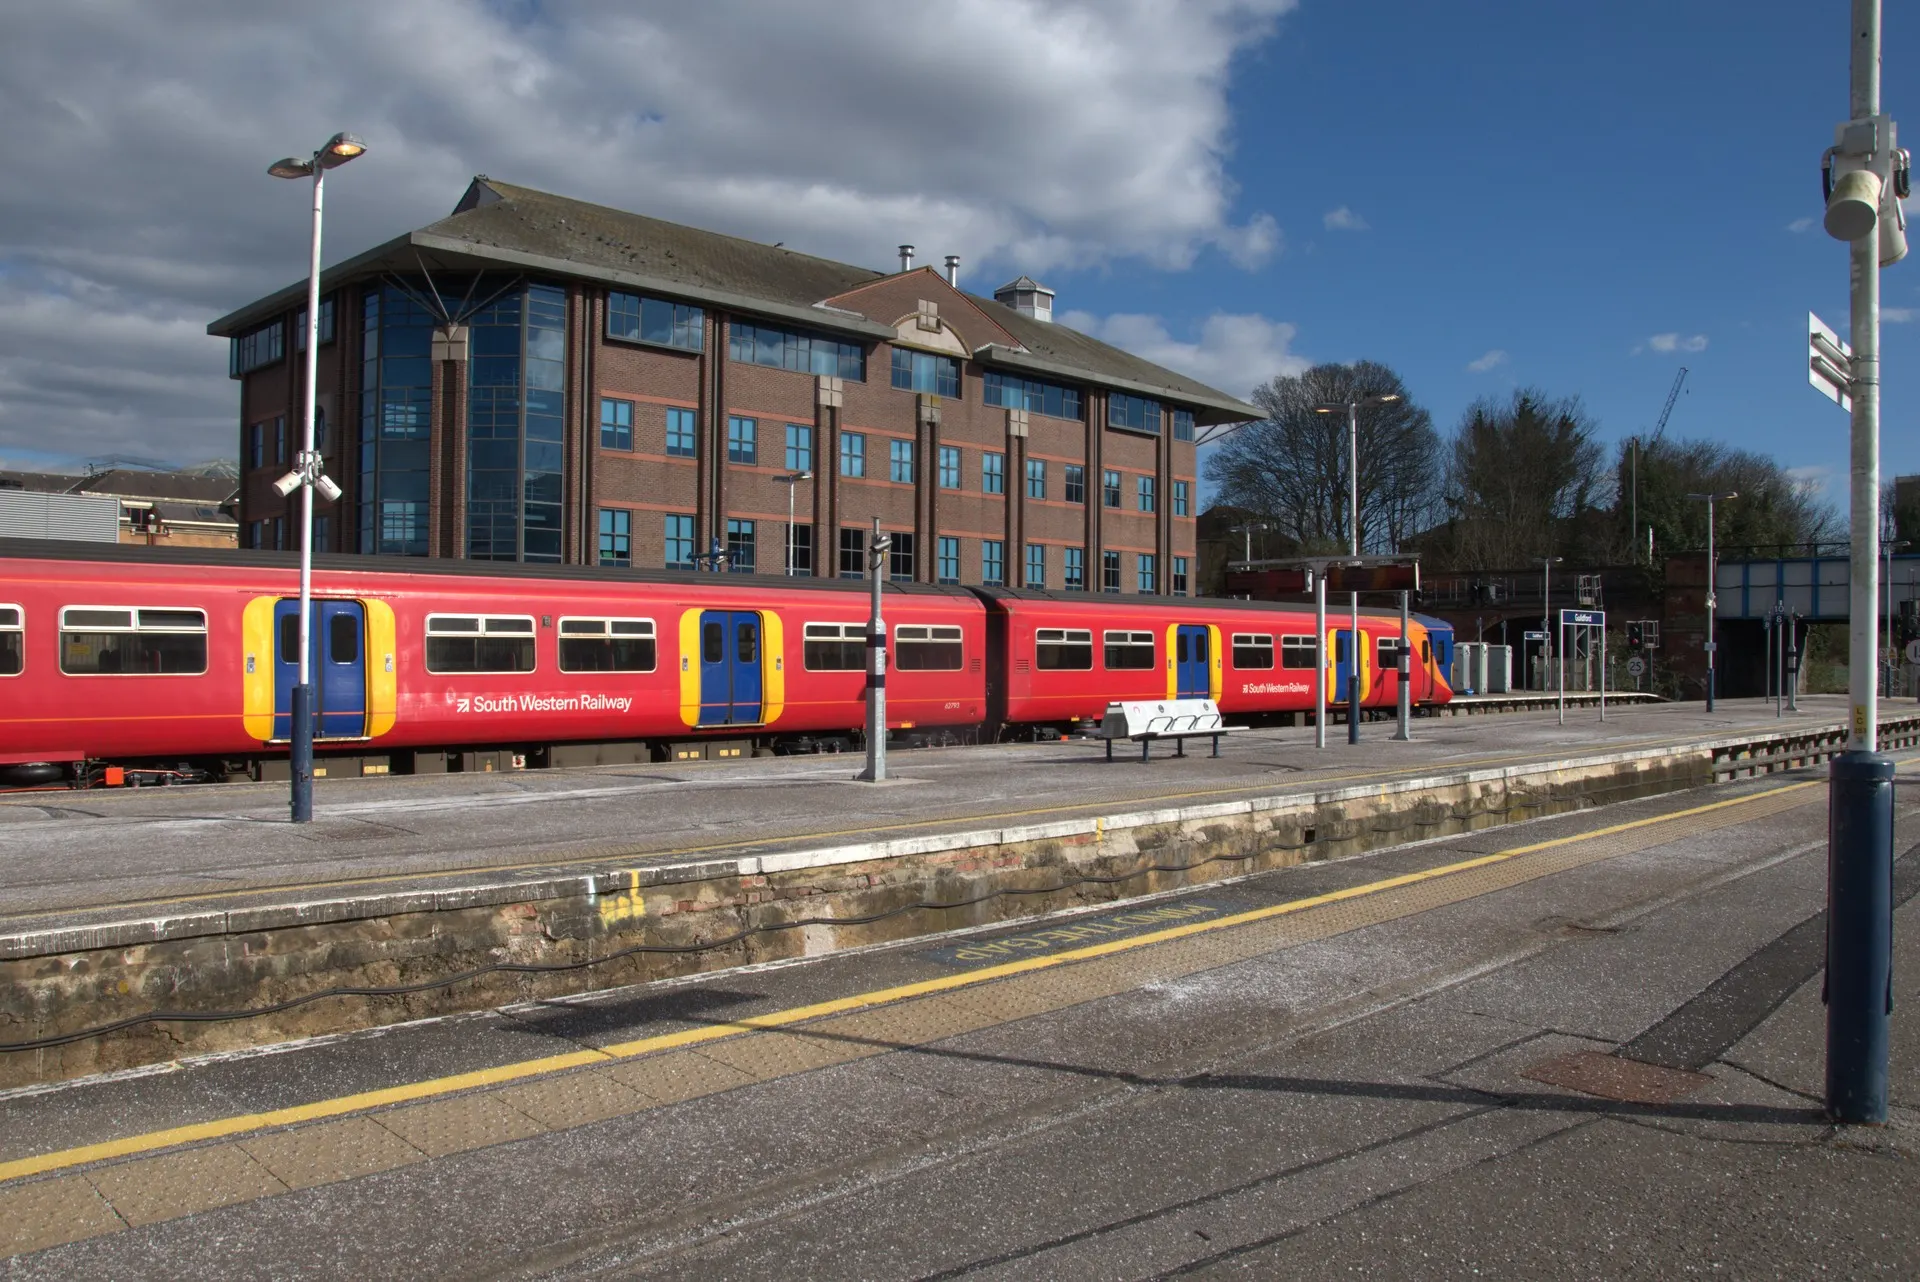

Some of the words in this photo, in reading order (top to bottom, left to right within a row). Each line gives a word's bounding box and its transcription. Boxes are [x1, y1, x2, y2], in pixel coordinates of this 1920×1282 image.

[1776, 615, 1783, 623] 8
[1630, 661, 1642, 671] 25
[1249, 683, 1266, 694] South
[1266, 682, 1289, 693] Western
[1289, 682, 1310, 694] Railway
[473, 695, 518, 713] South
[519, 694, 579, 711] Western
[580, 694, 632, 713] Railway
[1111, 904, 1218, 925] MIND
[1032, 922, 1131, 942] THE
[955, 938, 1050, 960] GAP
